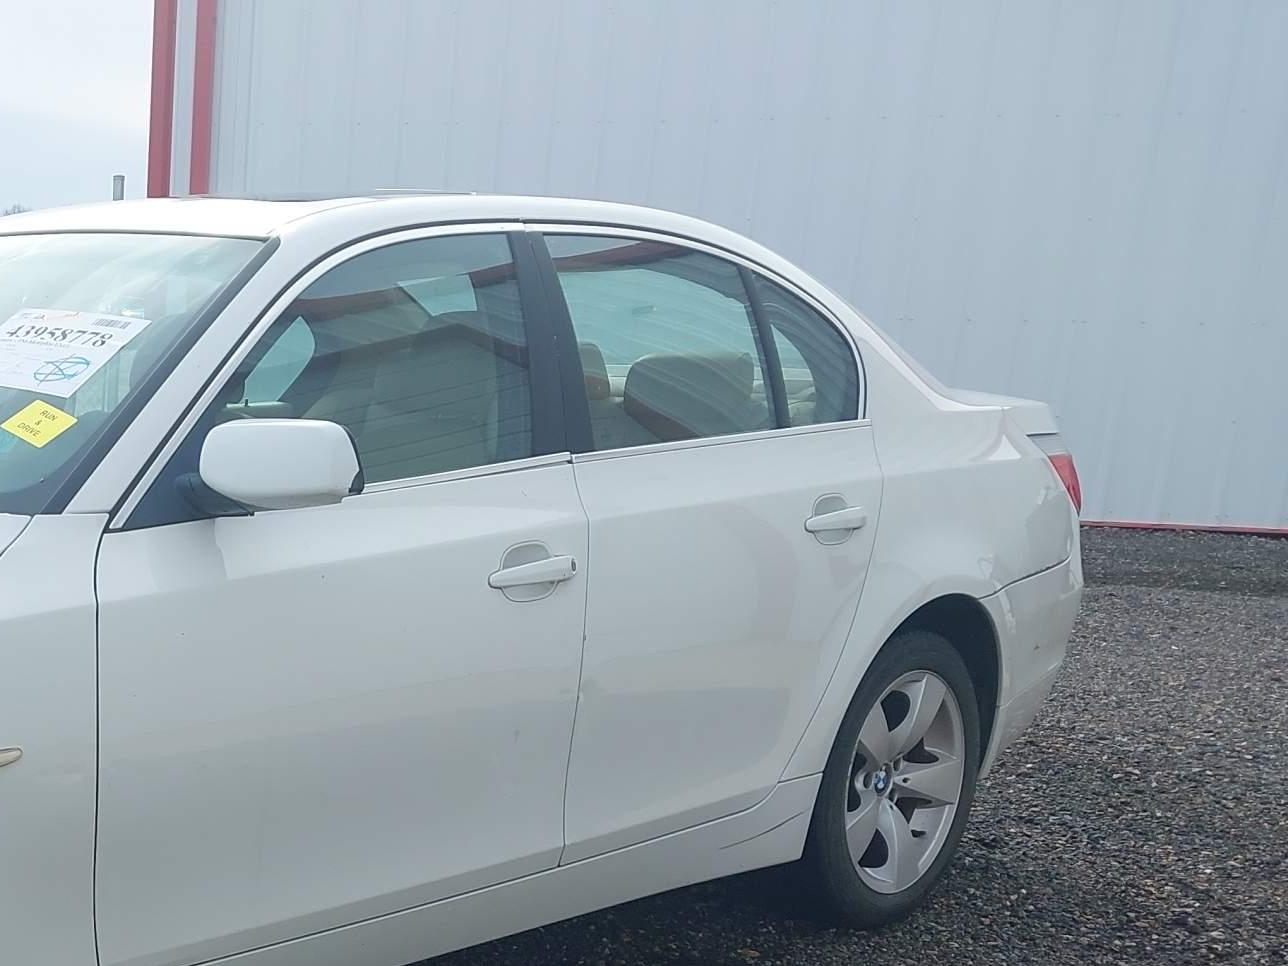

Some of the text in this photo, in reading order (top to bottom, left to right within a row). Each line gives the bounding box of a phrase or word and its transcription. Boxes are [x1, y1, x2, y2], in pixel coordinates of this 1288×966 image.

[5, 324, 113, 347] 43958778
[39, 409, 59, 422] RUN
[16, 422, 42, 438] DRIVE
